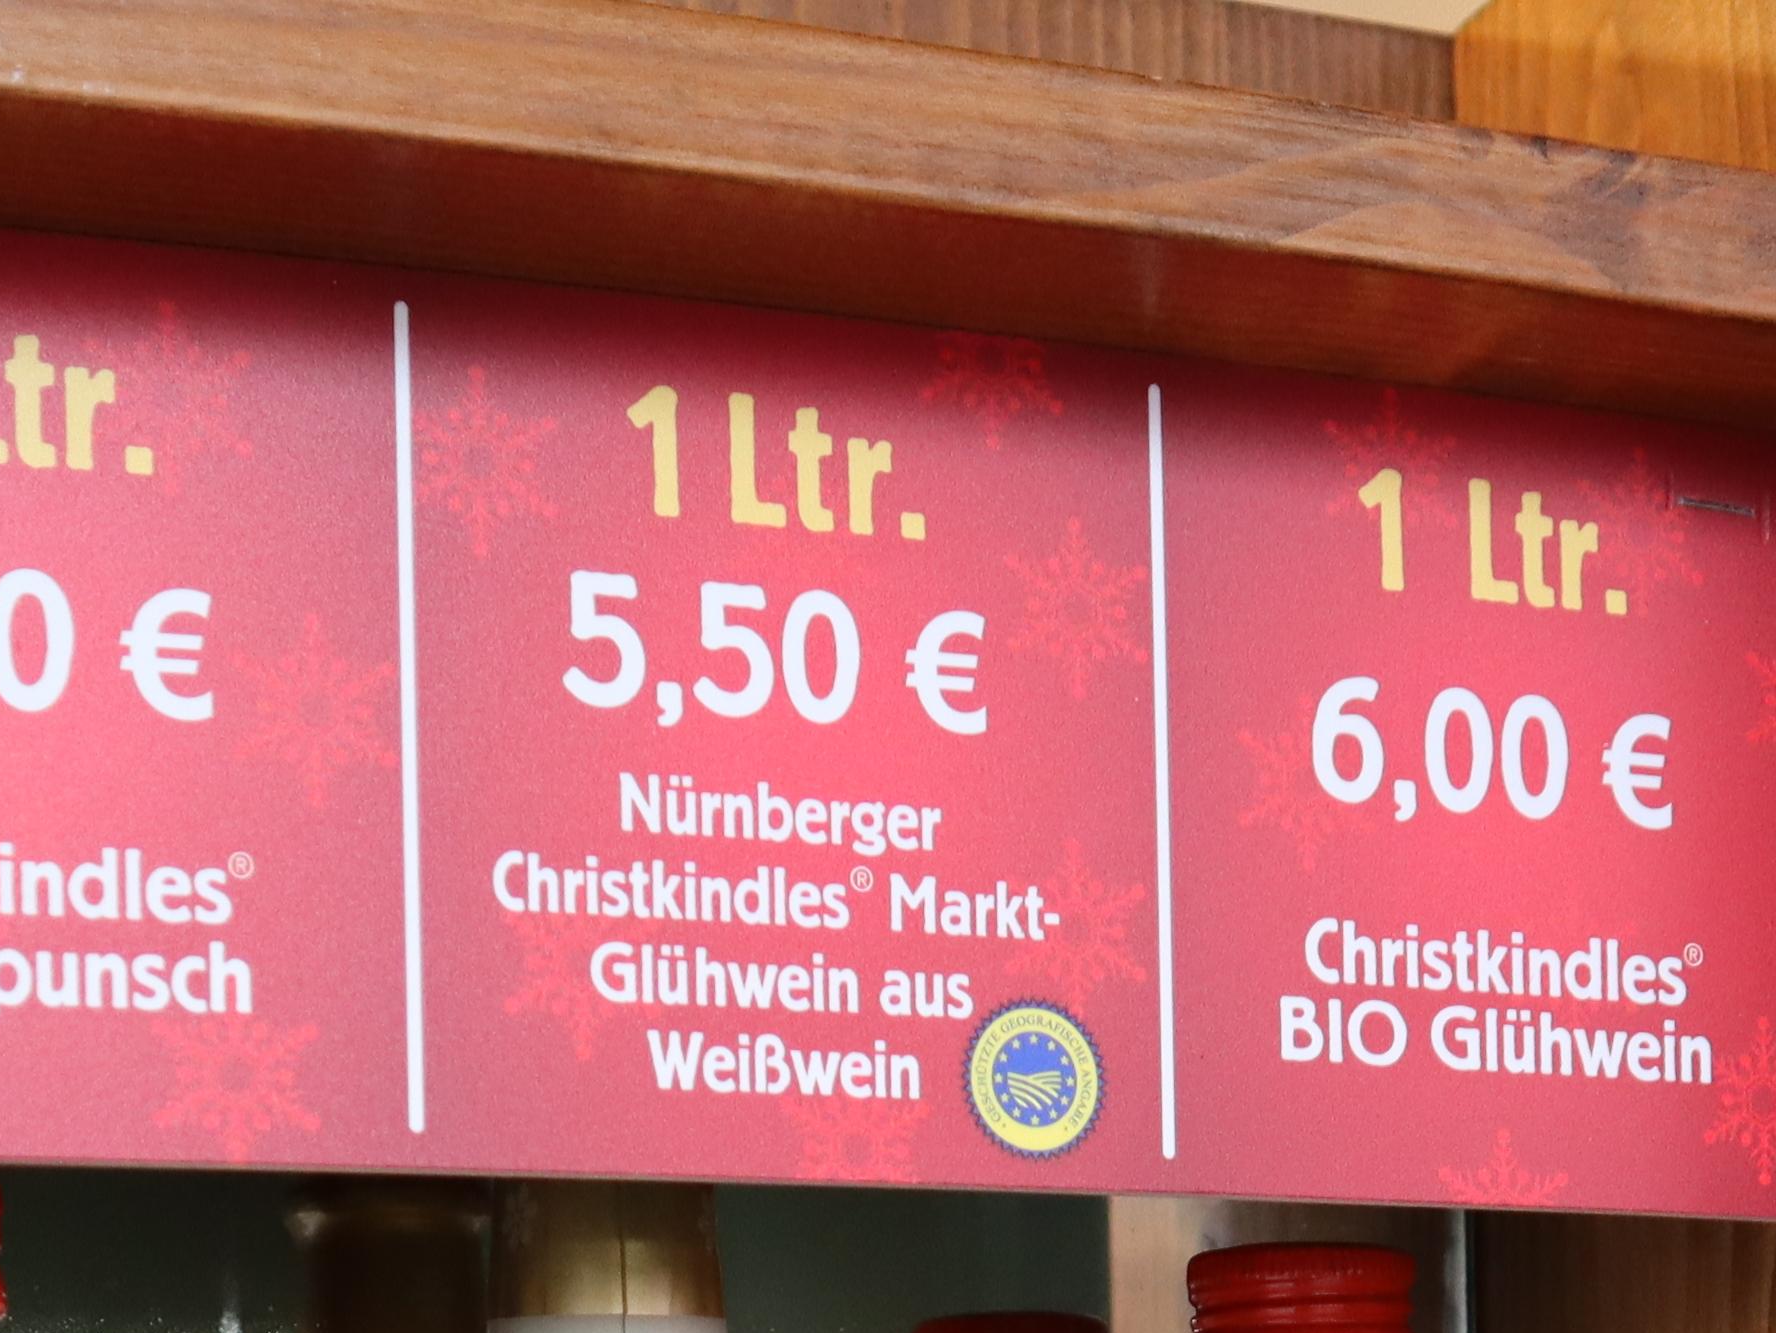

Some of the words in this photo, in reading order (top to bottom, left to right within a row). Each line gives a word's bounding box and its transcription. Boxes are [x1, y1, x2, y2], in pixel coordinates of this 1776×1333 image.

[627, 385, 680, 518] 1
[729, 391, 926, 541] Ltr.
[1358, 468, 1404, 592] 1
[1467, 478, 1627, 615] Ltr.
[119, 588, 215, 722] €
[563, 569, 861, 728] 5,50
[905, 609, 988, 735] €
[1311, 676, 1569, 822] 6,00
[1601, 714, 1672, 830] €
[619, 772, 942, 857] Nürnberger
[891, 873, 1060, 942] Markt-
[590, 942, 859, 1015] Glühwein
[880, 968, 973, 1020] aus
[648, 1029, 921, 1101] Weißwein
[1279, 995, 1407, 1067] BIO
[1431, 1007, 1712, 1084] Glühwein
